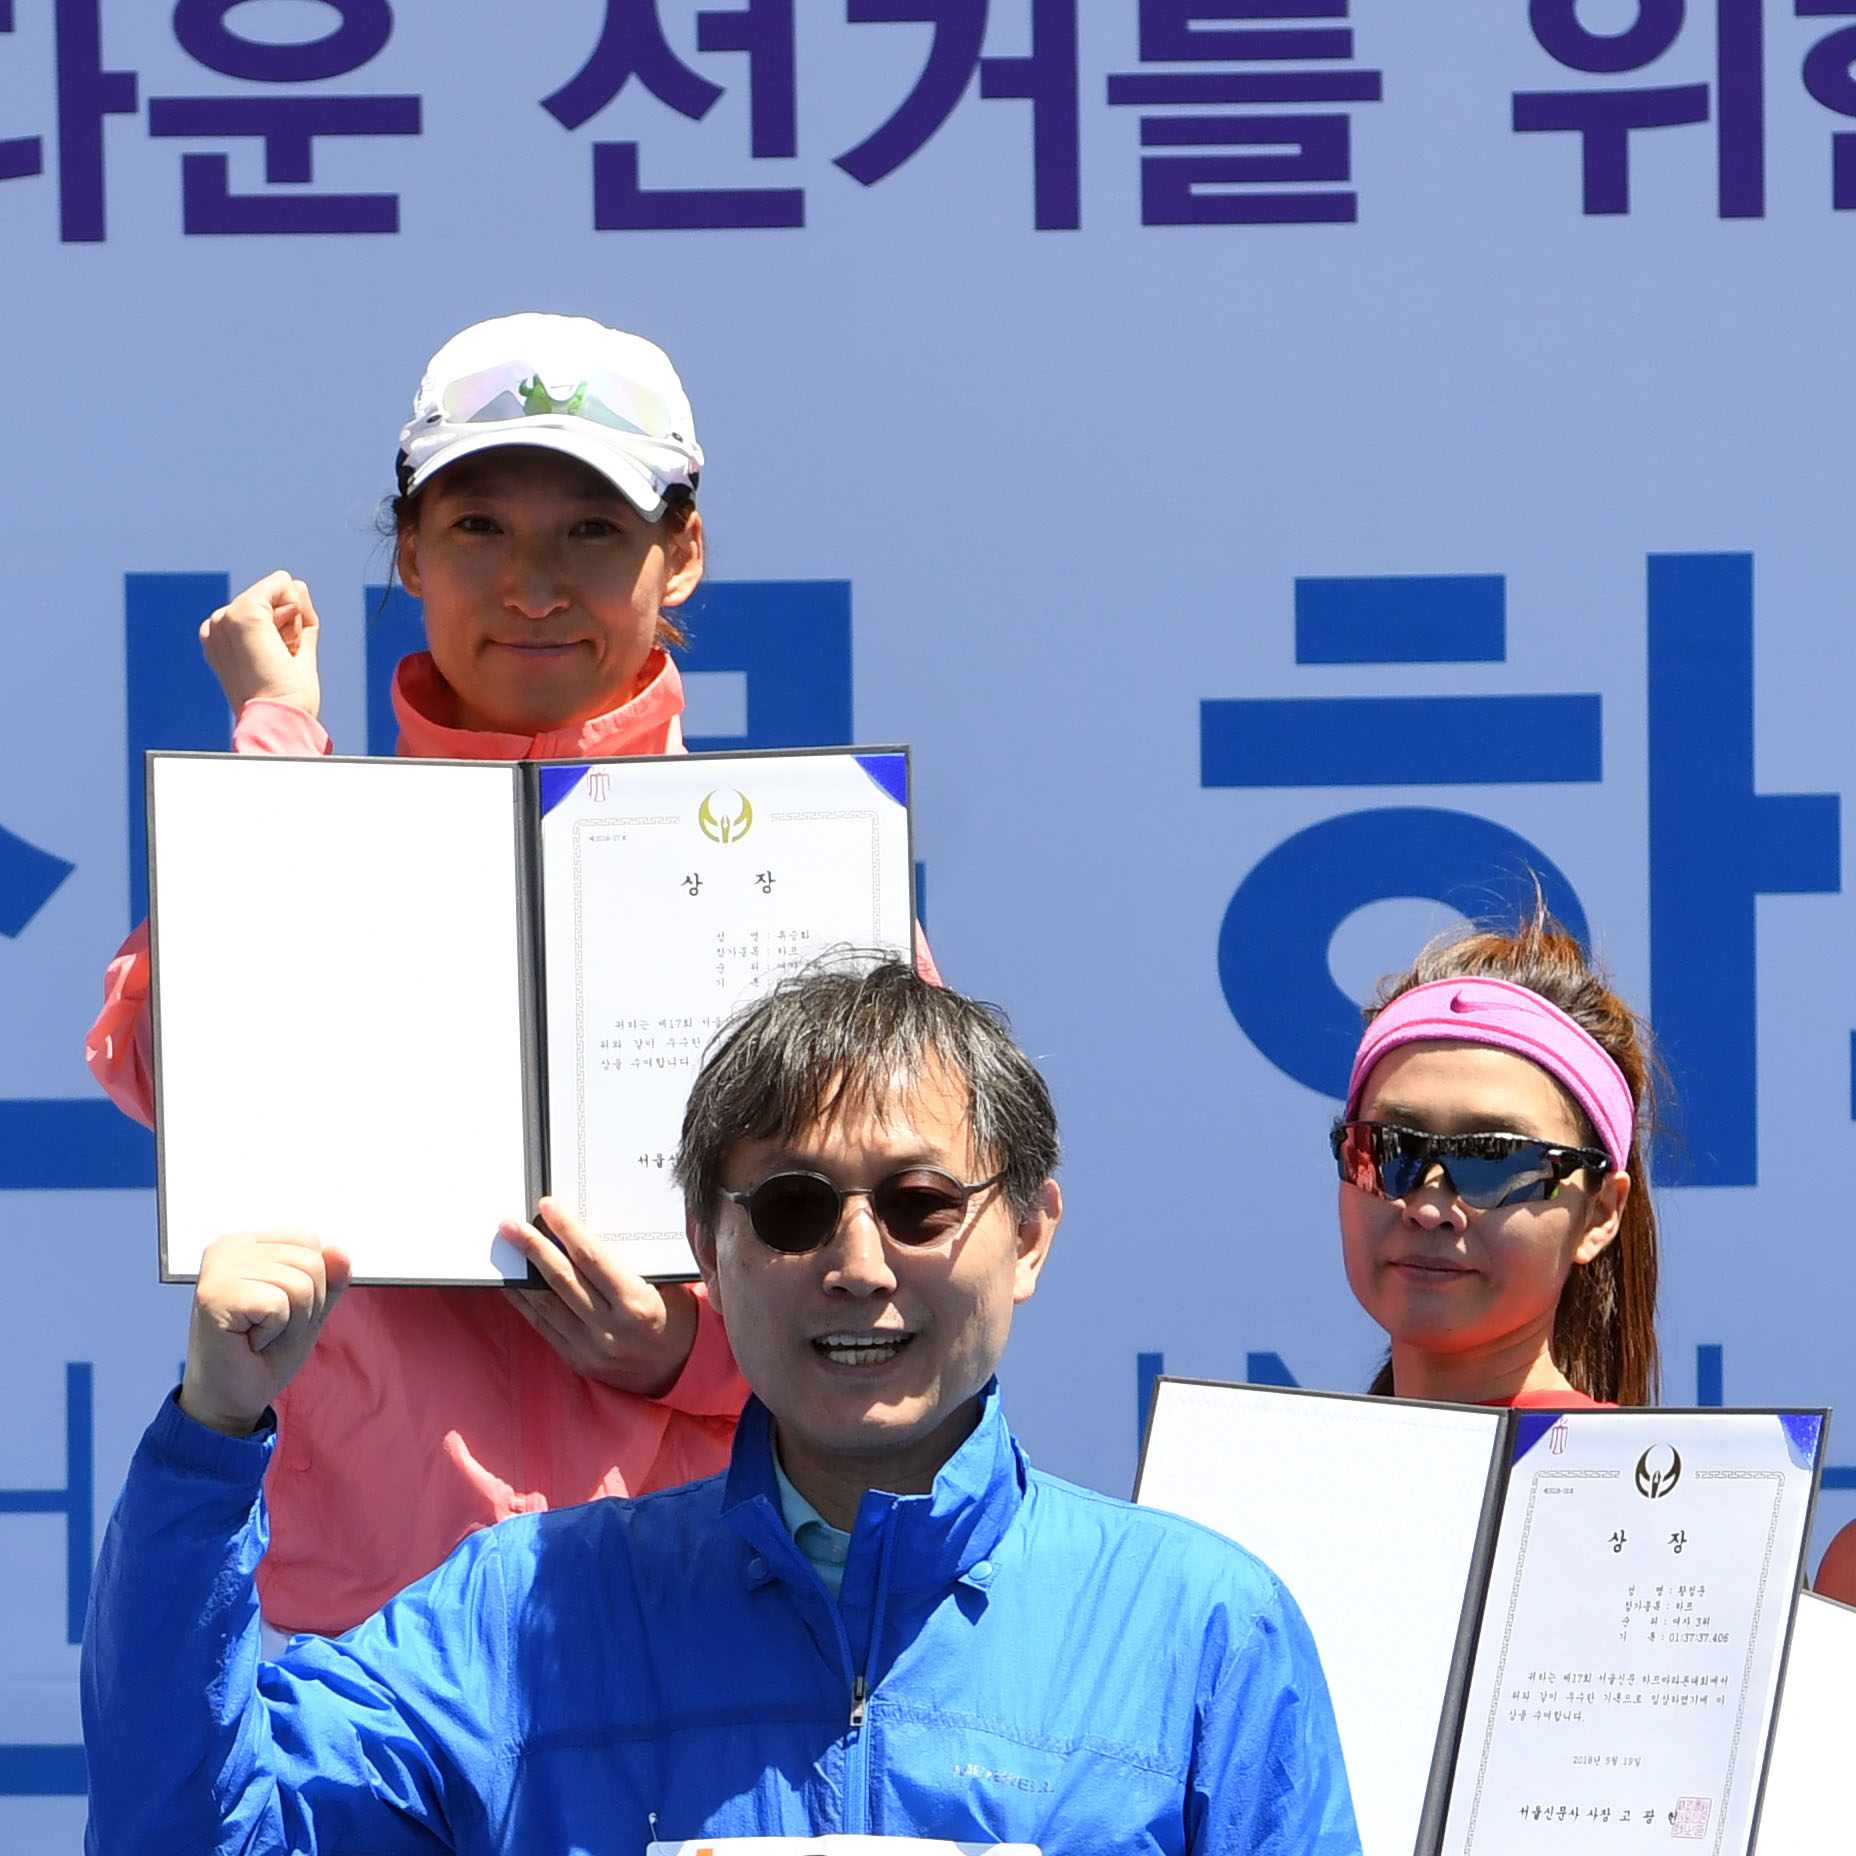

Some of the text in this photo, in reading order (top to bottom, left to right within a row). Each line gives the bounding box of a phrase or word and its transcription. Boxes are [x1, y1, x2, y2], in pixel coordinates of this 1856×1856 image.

[540, 0, 1384, 232] 선거를
[680, 870, 776, 897] 상 장
[614, 1018, 650, 1031] 귀하는
[658, 1017, 693, 1029] 제17회
[1607, 1528, 1688, 1554] 상 장
[1675, 1600, 1694, 1612] 하프
[1672, 1616, 1691, 1628] 여자
[1695, 1616, 1711, 1628] 3위
[1527, 1671, 1728, 1688] 귀하는 제17회 서울신문 하프마라톤대회에서
[1512, 1690, 1531, 1702] 위와
[1539, 1691, 1558, 1703] 같이
[1565, 1692, 1596, 1704] 우수한
[1603, 1692, 1643, 1704] 기록으로
[1508, 1709, 1527, 1723] 상을
[1517, 1804, 1580, 1823] 서울신문사
[1586, 1805, 1611, 1823] 사장
[1619, 1809, 1631, 1822] 고
[1642, 1808, 1655, 1825] 광
